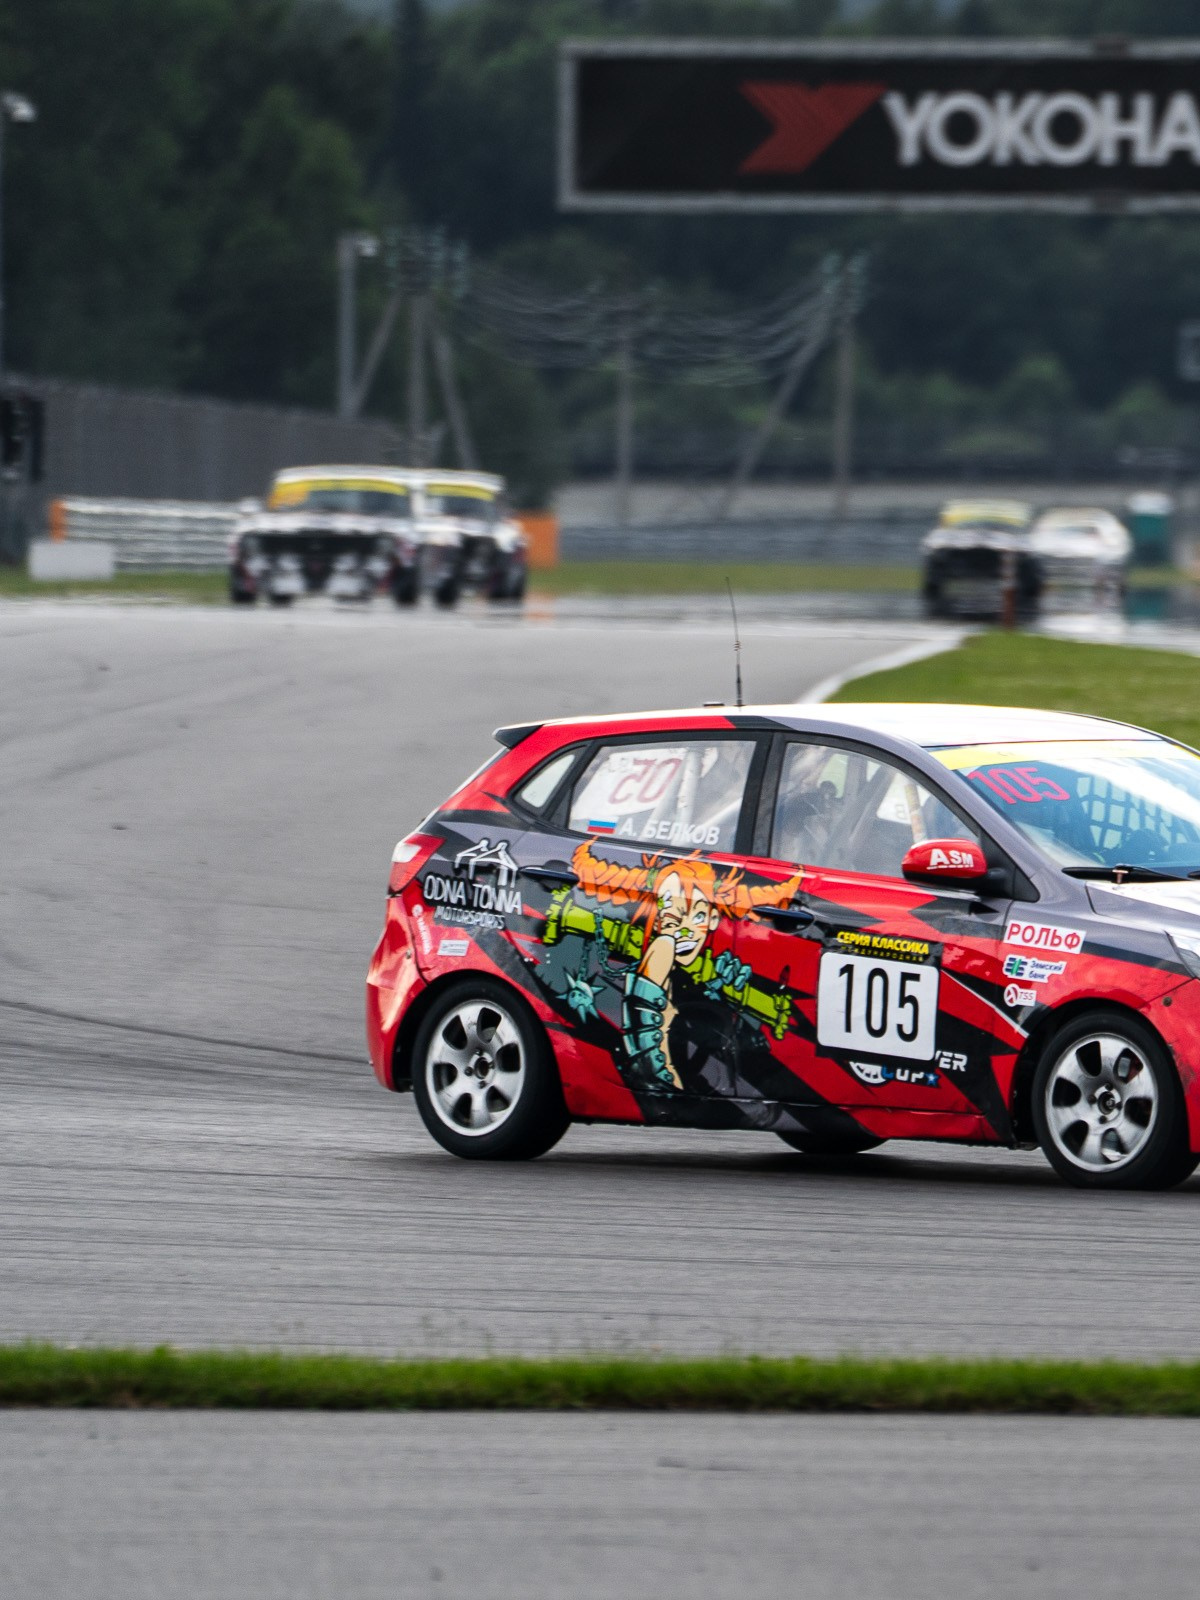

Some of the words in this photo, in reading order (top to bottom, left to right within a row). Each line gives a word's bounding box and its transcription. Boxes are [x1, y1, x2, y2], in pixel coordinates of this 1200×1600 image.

[966, 767, 1070, 805] 105
[645, 820, 720, 846] БЕЛКОВ
[423, 875, 466, 906] ODNA
[836, 931, 870, 947] СЕРИЯ
[872, 936, 929, 955] КЛАССИКА
[1008, 923, 1081, 949] РОЛЬФ
[839, 963, 921, 1042] 105
